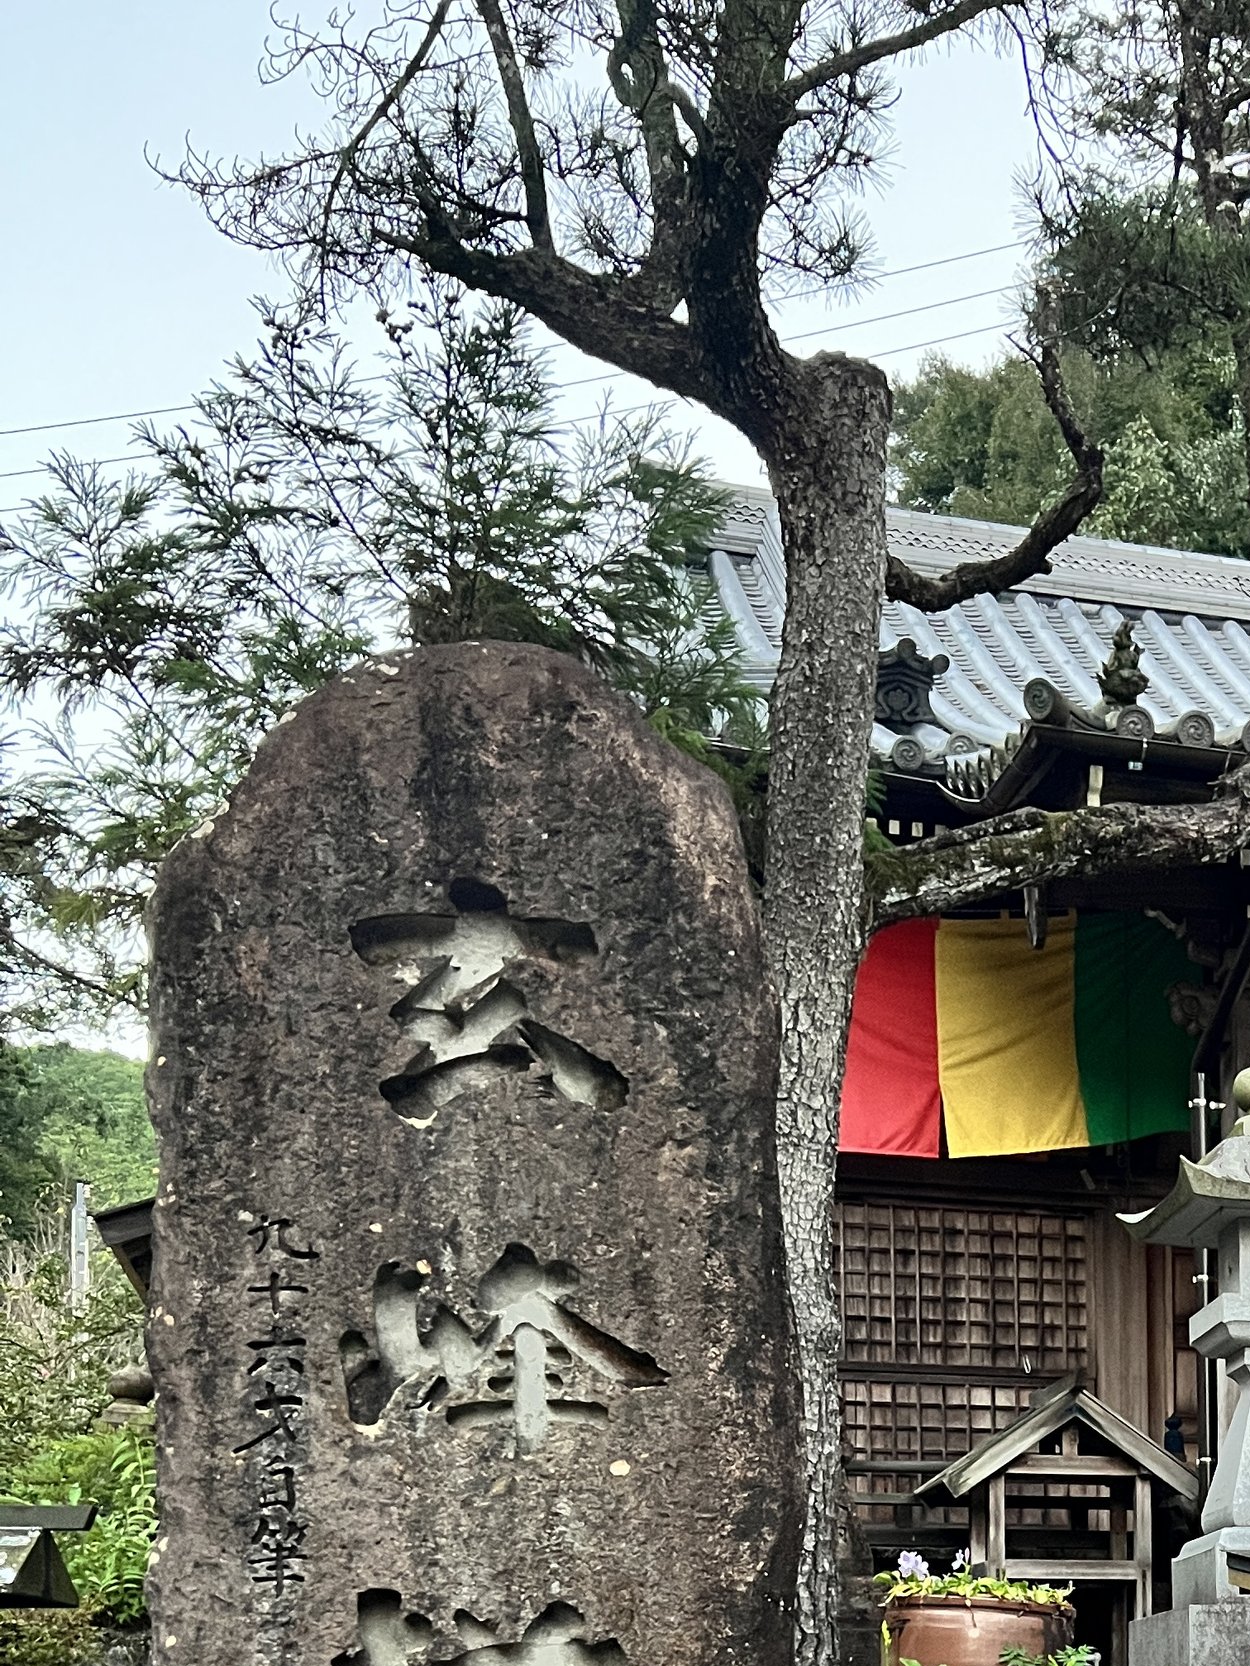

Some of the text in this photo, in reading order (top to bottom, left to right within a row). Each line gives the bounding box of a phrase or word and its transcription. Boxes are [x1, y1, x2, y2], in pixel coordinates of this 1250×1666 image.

[233, 1214, 319, 1593] 九十六才自筆
